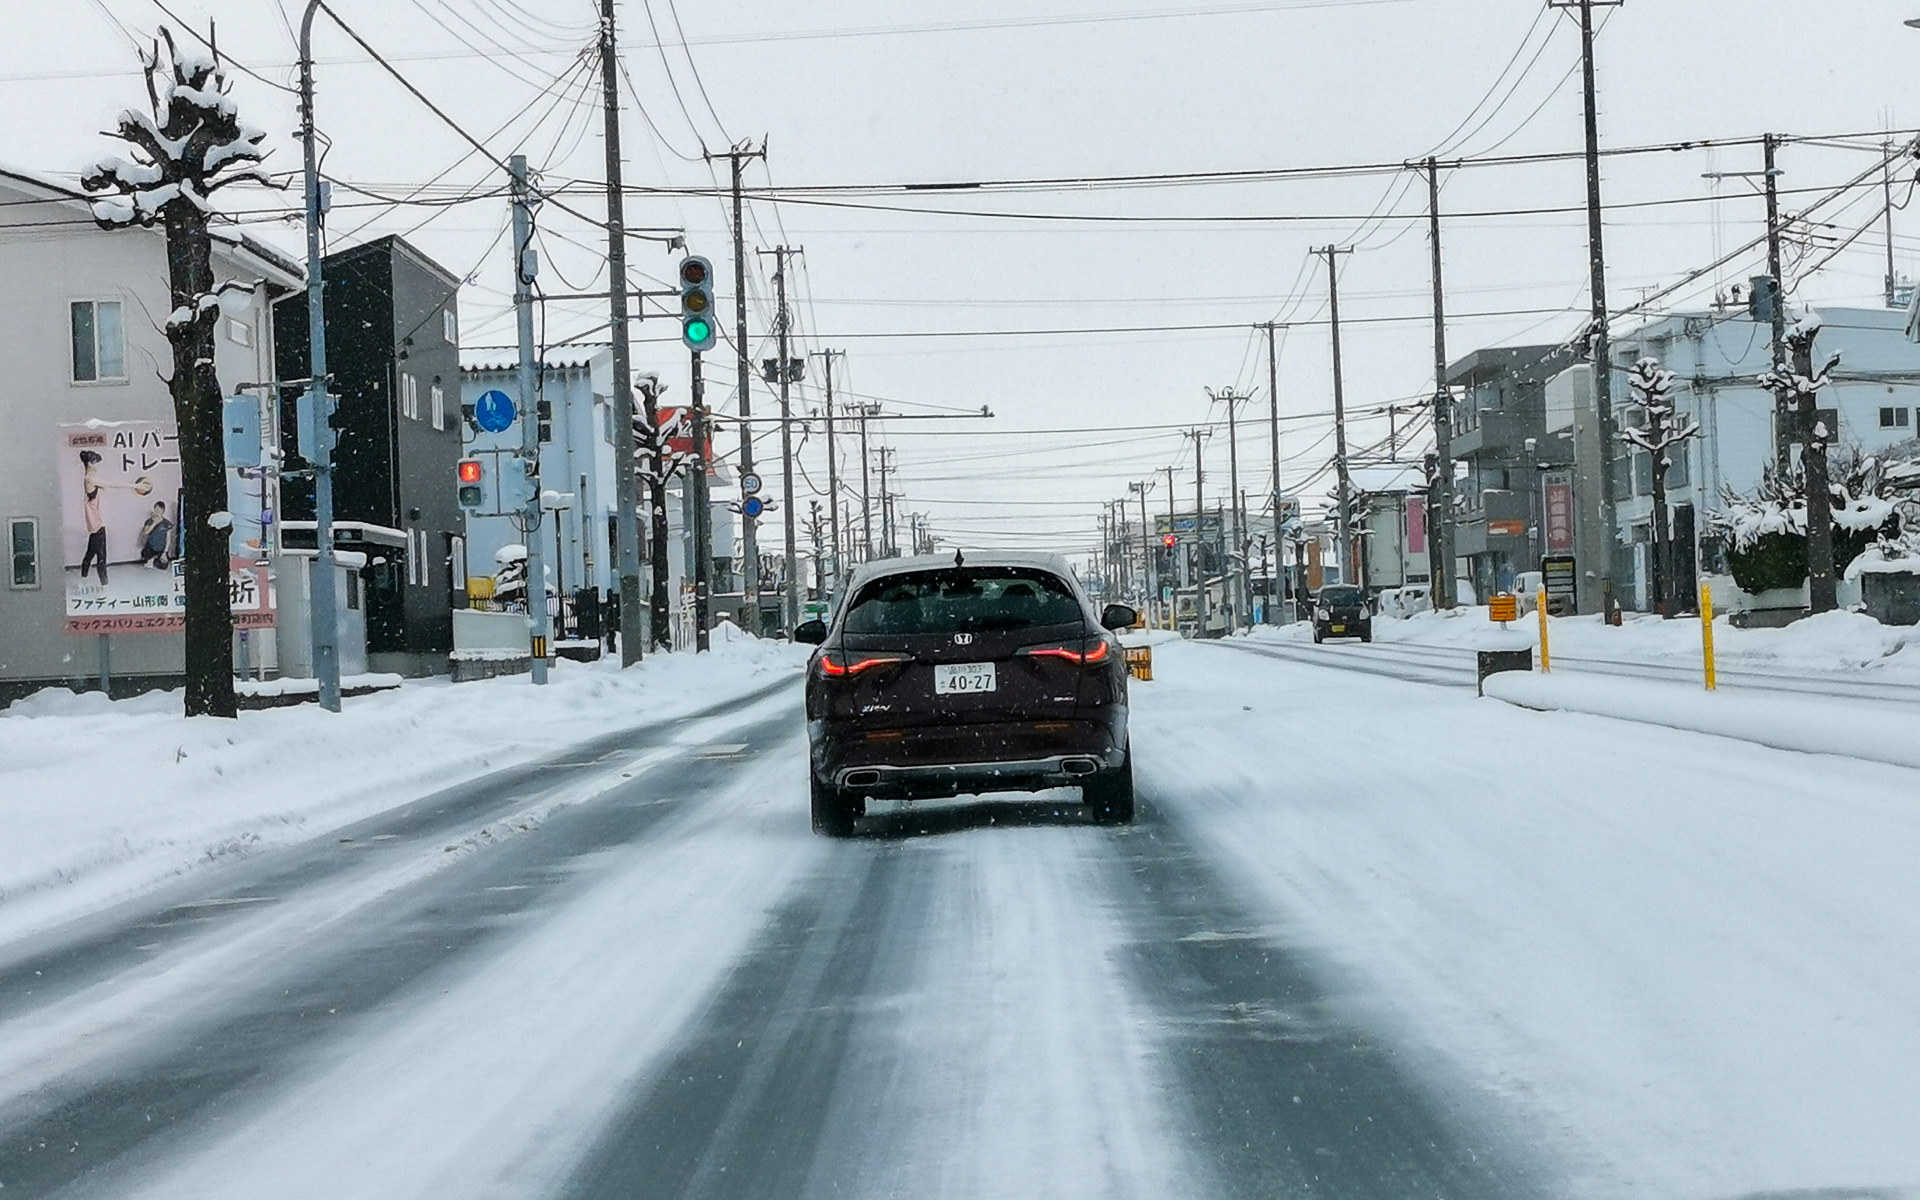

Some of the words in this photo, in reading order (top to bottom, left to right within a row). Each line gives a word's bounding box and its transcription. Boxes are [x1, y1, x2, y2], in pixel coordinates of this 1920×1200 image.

[113, 431, 133, 448] AI
[123, 453, 179, 471] トレー
